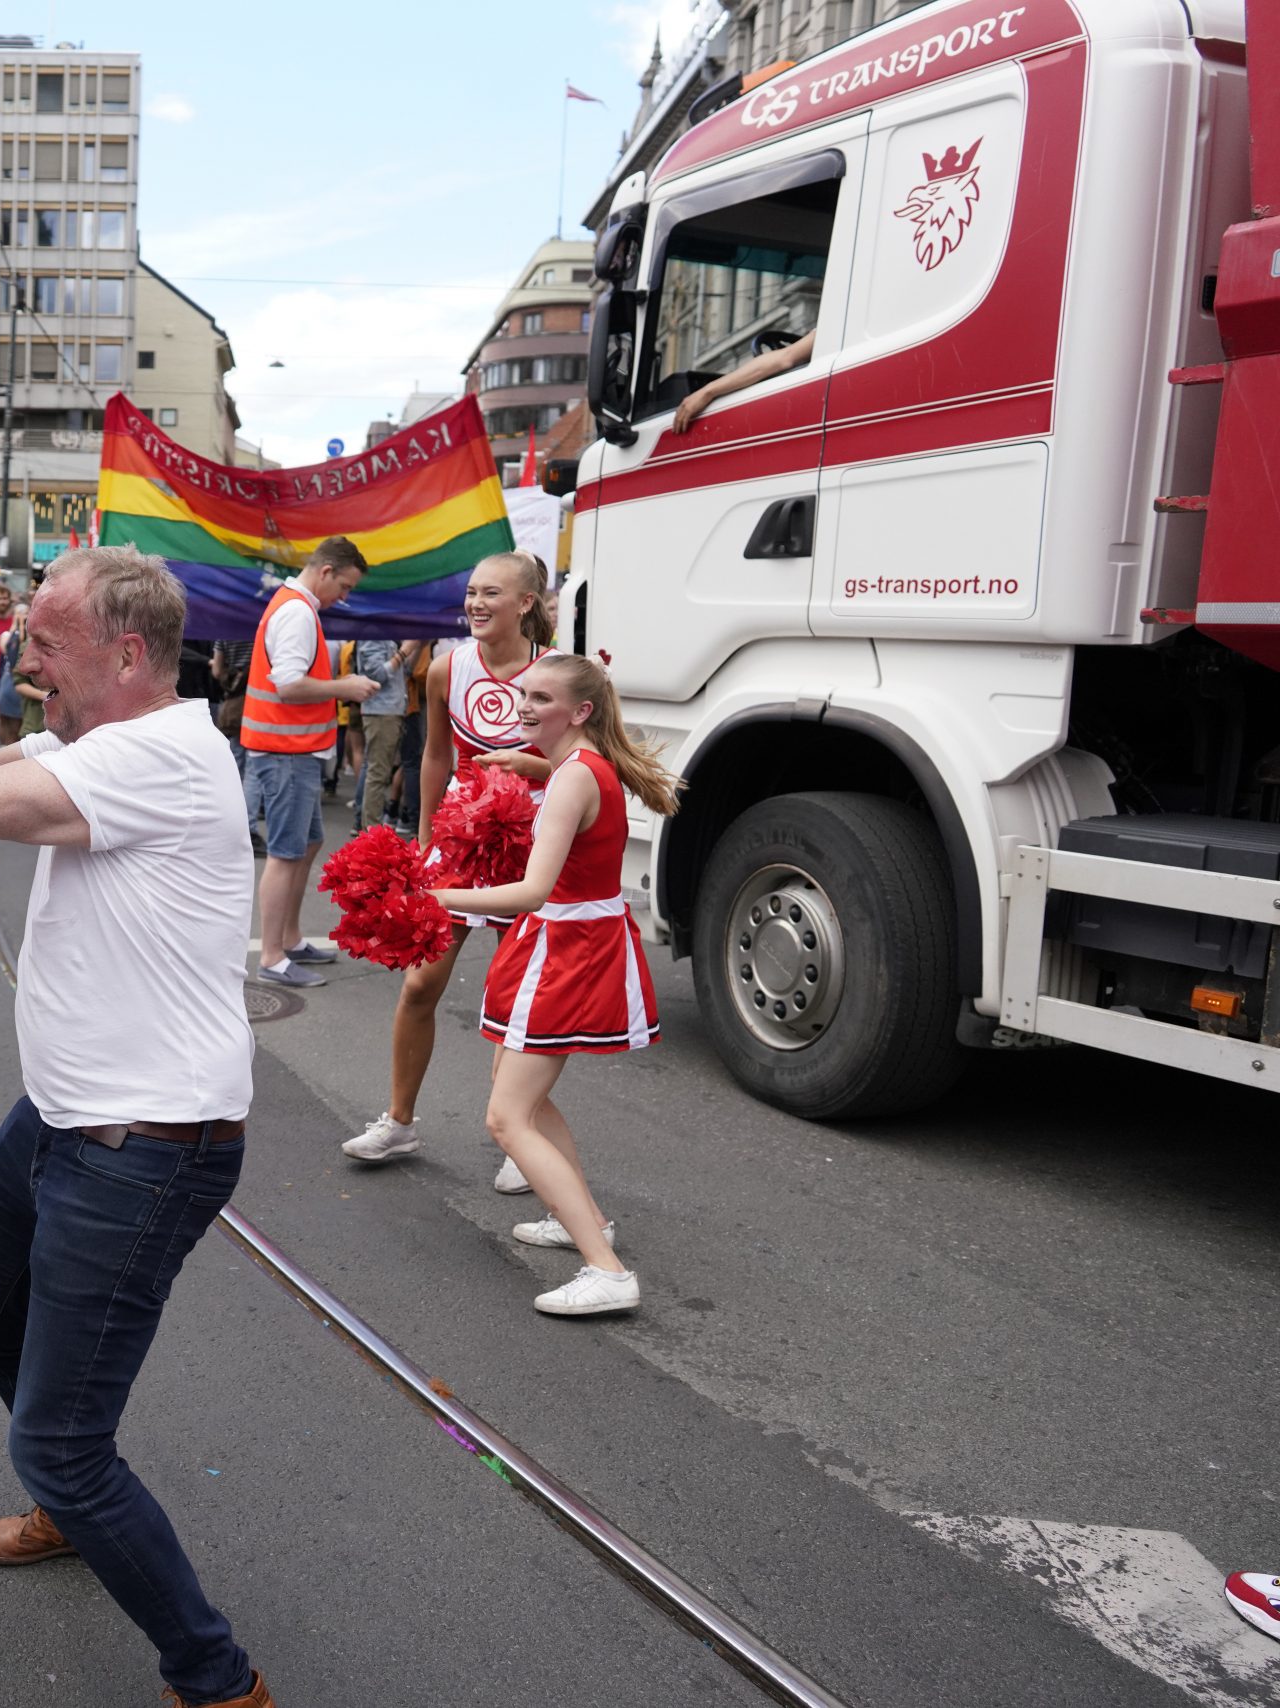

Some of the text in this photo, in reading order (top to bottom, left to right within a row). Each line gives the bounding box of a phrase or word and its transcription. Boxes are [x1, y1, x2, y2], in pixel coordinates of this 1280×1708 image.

[739, 6, 1026, 130] GS TRANSPORT
[844, 575, 1020, 599] gs-transport.no
